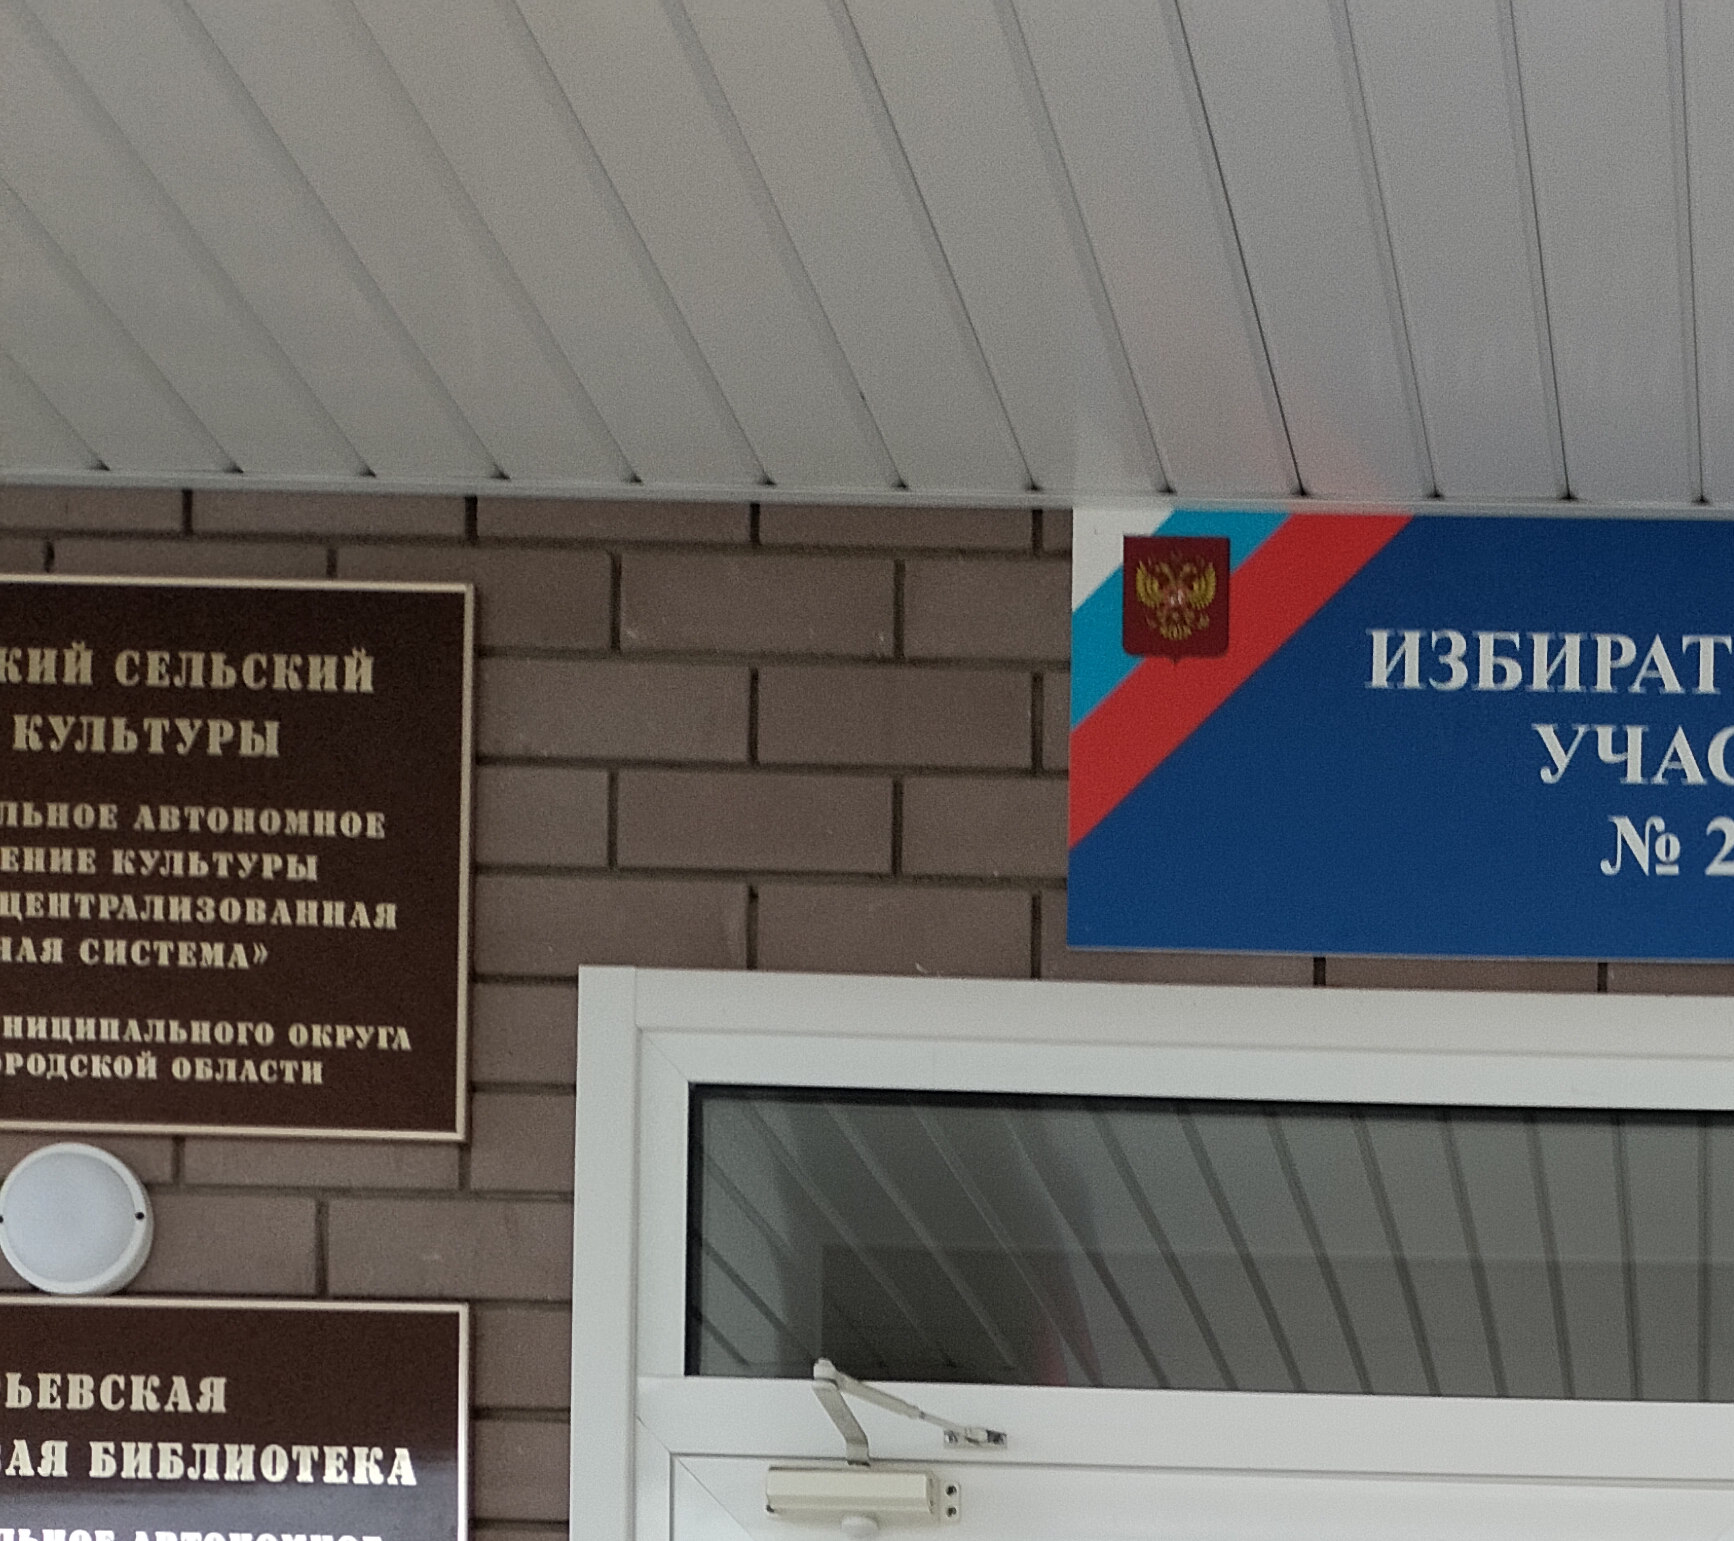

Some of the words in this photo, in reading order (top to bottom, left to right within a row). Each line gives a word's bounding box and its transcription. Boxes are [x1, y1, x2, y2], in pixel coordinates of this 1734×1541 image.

[114, 646, 375, 694] СЕЛЬСКИЙ
[11, 713, 280, 758] КУЛЬТУРЫ
[132, 804, 386, 839] АВТОНОМНОЕ
[111, 848, 318, 882] КУЛЬТУРЫ
[1599, 815, 1681, 876] №
[78, 937, 269, 970] СИСТЕМА»
[2, 1014, 275, 1046] НИЦИПАЛЬНОГО
[287, 1022, 412, 1051] ОКРУГА
[0, 1048, 158, 1081] РОДСКОЙ
[171, 1056, 324, 1085] ОБЛАСТИ
[3, 1371, 227, 1414] ЬЕВСКАЯ
[88, 1440, 419, 1487] БИБЛИОТЕКА
